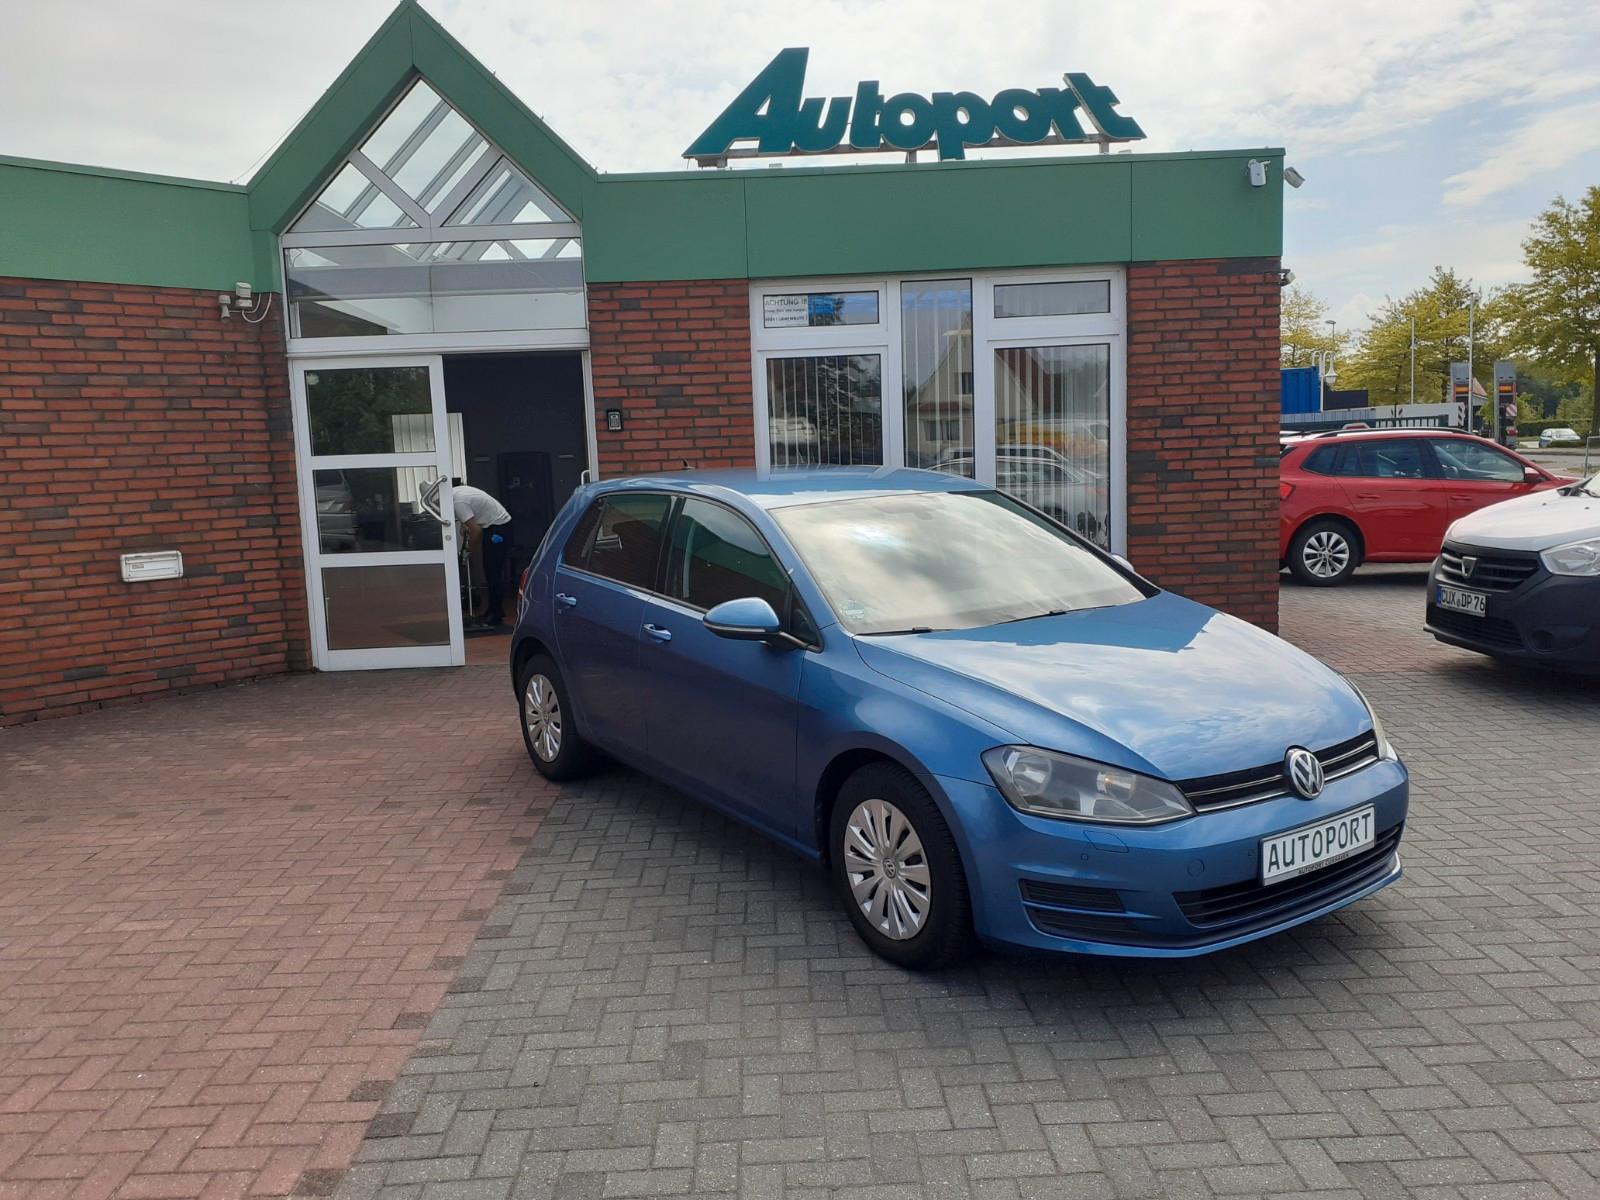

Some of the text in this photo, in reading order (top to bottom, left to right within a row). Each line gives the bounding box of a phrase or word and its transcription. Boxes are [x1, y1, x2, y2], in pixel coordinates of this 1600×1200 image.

[681, 47, 1147, 162] Autoport
[765, 297, 799, 306] ACHTUNG
[1441, 589, 1486, 611] CUX DP 76
[1267, 812, 1371, 873] AUTOPORT
